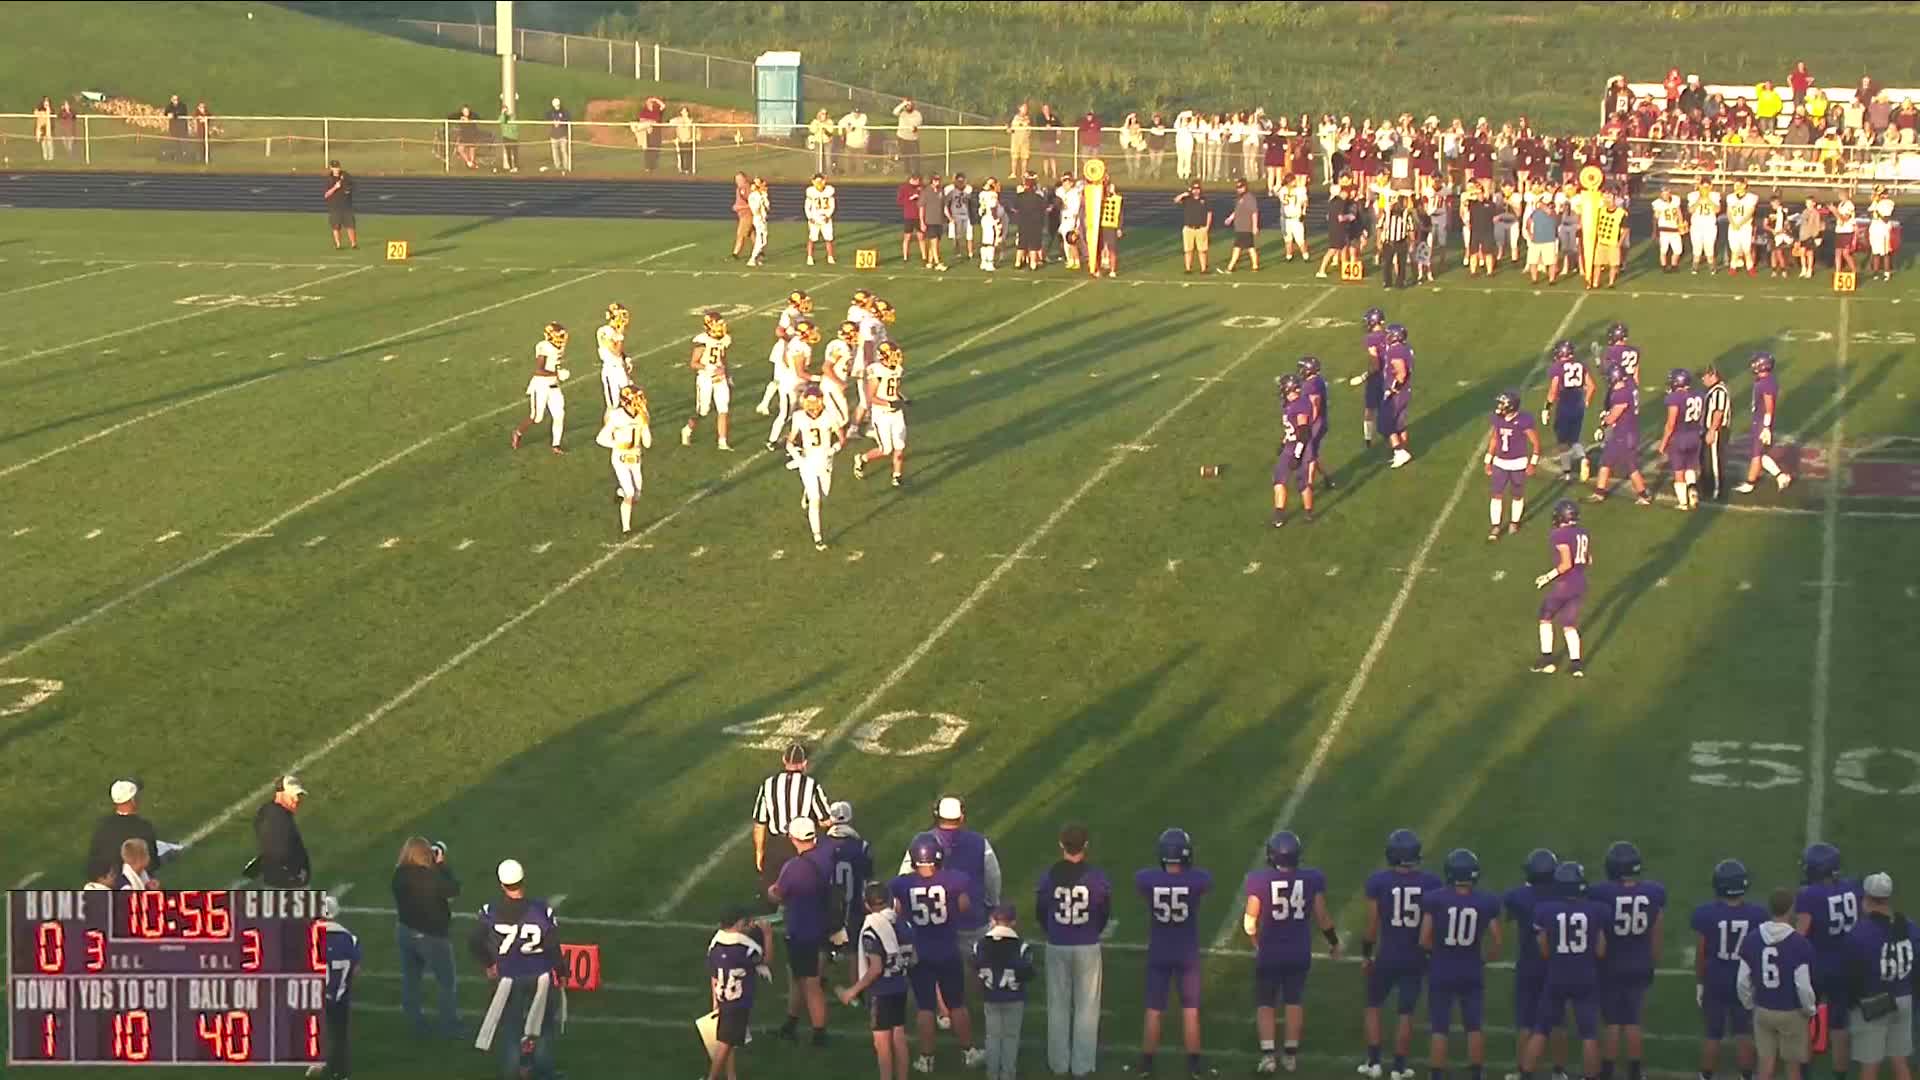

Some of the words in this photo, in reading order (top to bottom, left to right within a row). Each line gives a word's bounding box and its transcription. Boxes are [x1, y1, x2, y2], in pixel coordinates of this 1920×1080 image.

[390, 244, 404, 257] 20
[859, 251, 874, 265] 30
[1344, 264, 1360, 277] 40
[1838, 275, 1852, 289] 50
[1563, 362, 1584, 388] 23
[1621, 351, 1639, 375] 22
[1684, 396, 1703, 422] 28
[810, 427, 821, 447] 3
[908, 885, 949, 927] 53
[1053, 885, 1090, 925] 32
[1153, 886, 1190, 923] 55
[1270, 880, 1305, 921] 54
[1391, 886, 1422, 928] 15
[1614, 895, 1650, 936] 56
[1828, 891, 1859, 935] 59
[494, 924, 544, 955] 72
[1444, 907, 1478, 947] 10
[1556, 912, 1589, 954] 13
[1717, 919, 1750, 961] 17
[1761, 946, 1781, 989] 6
